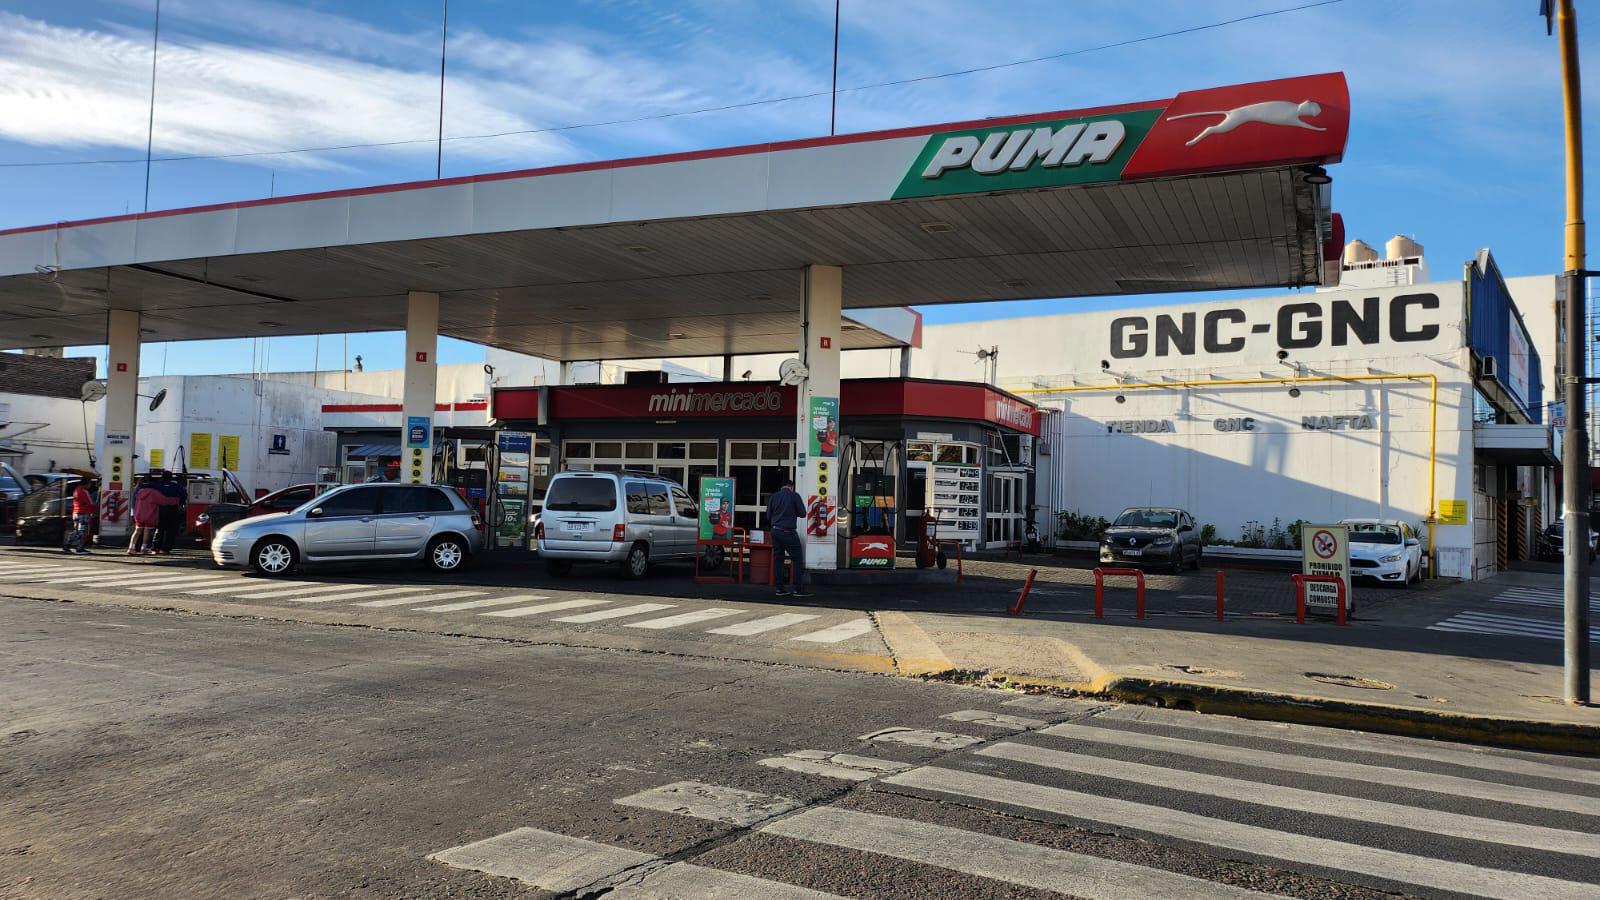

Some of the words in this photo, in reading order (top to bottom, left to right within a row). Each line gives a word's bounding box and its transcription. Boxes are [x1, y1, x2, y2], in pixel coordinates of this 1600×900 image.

[921, 120, 1126, 179] PUMA
[1110, 292, 1440, 360] GNC-GNC
[648, 386, 782, 412] minimercado
[1105, 419, 1172, 434] TIENDA
[1213, 417, 1256, 432] GNC
[1302, 415, 1373, 431] NAFTA
[859, 558, 888, 566] PUMA
[1309, 561, 1343, 571] PROHIBIDO
[1309, 583, 1337, 593] DESCARGA
